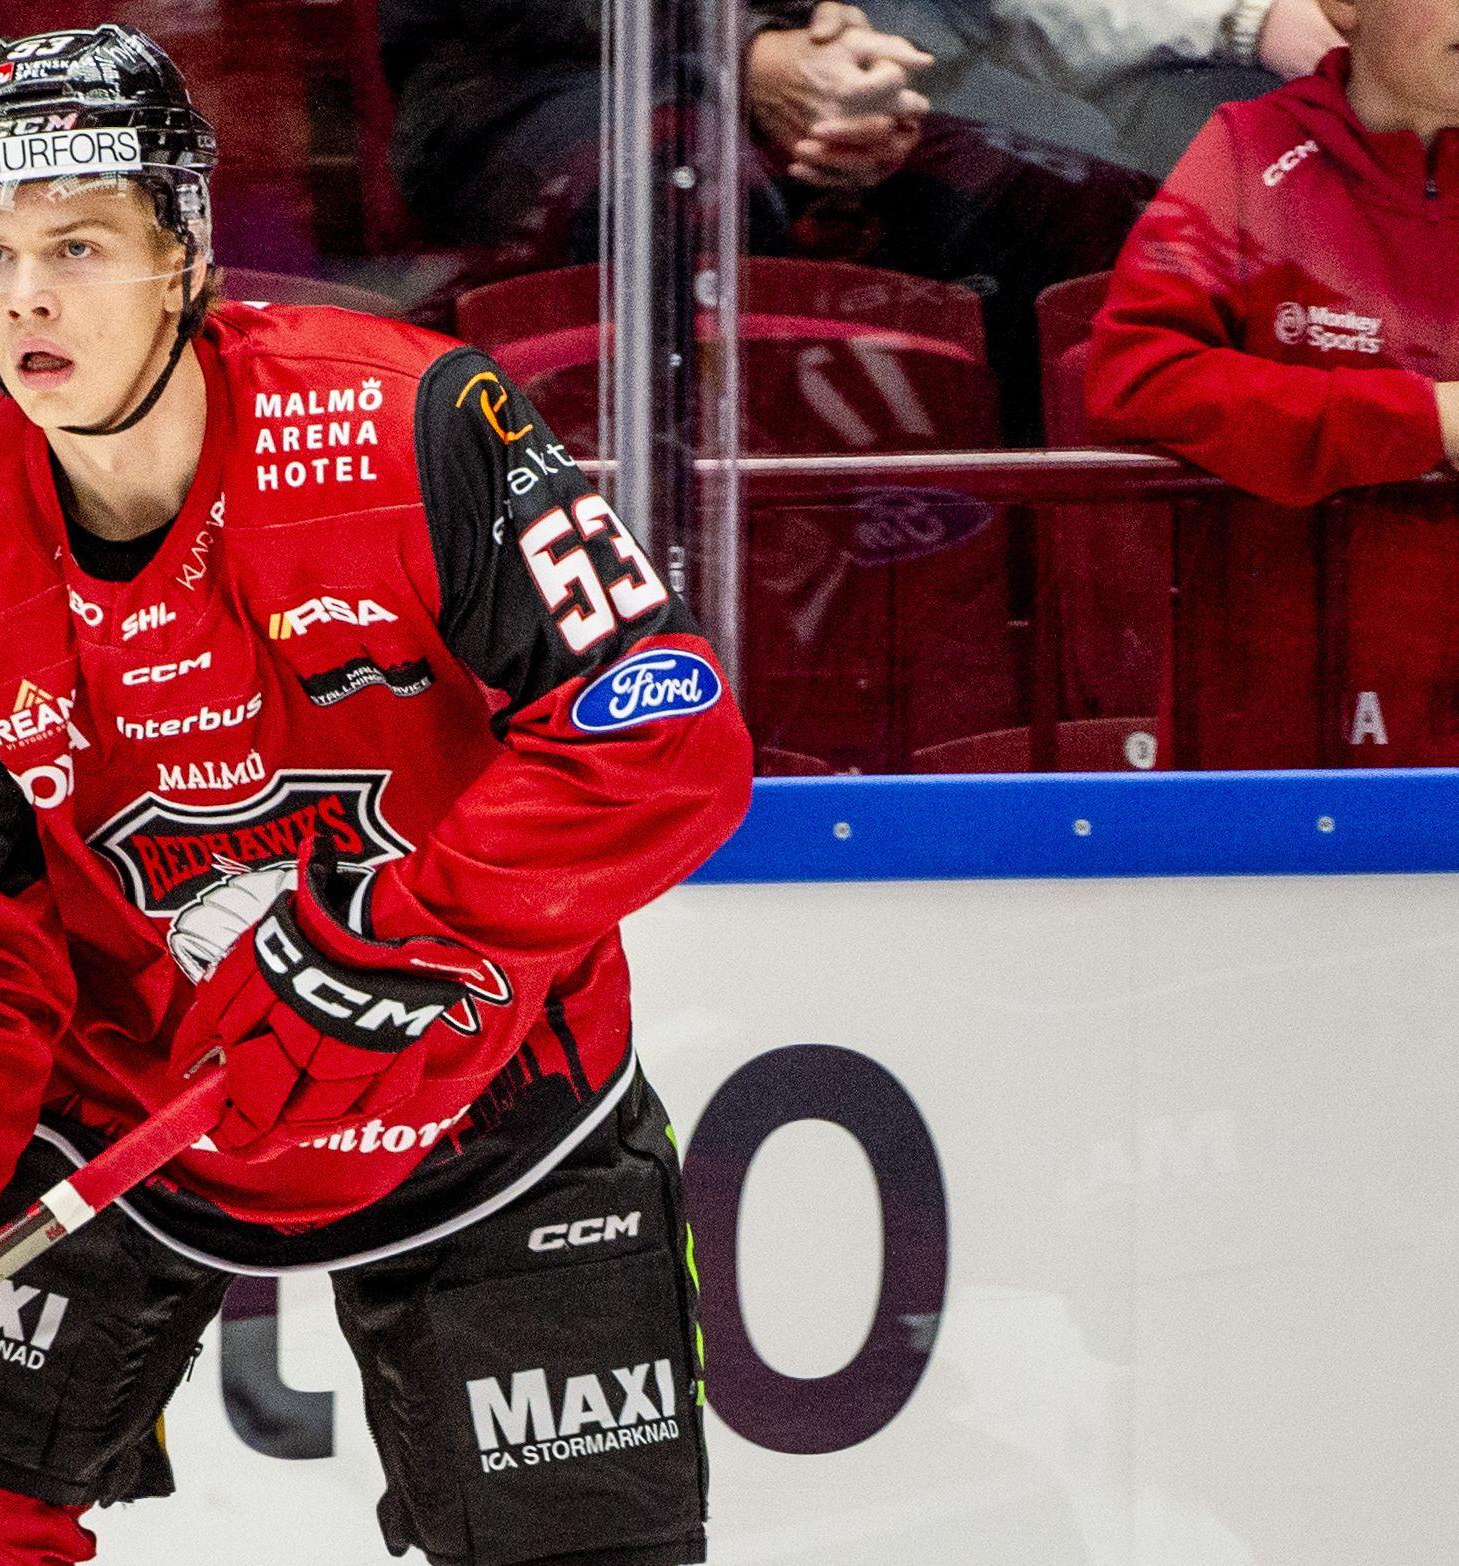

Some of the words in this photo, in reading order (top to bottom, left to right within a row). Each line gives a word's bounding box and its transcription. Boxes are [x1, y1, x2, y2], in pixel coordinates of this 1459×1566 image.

[255, 420, 378, 454] ARENA
[256, 455, 378, 492] HOTEL
[517, 493, 669, 656] 53
[121, 601, 177, 642] SHL
[122, 651, 212, 686] CCM
[609, 659, 703, 719] Ford
[116, 693, 263, 740] Interbus
[1349, 691, 1389, 745] A
[130, 795, 364, 901] REDHAWKS
[255, 916, 446, 1037] CCM
[528, 1211, 643, 1252] CCM
[466, 1357, 677, 1452] MAXI
[481, 1449, 520, 1473] ICA
[521, 1418, 680, 1467] STORMARKNAD
